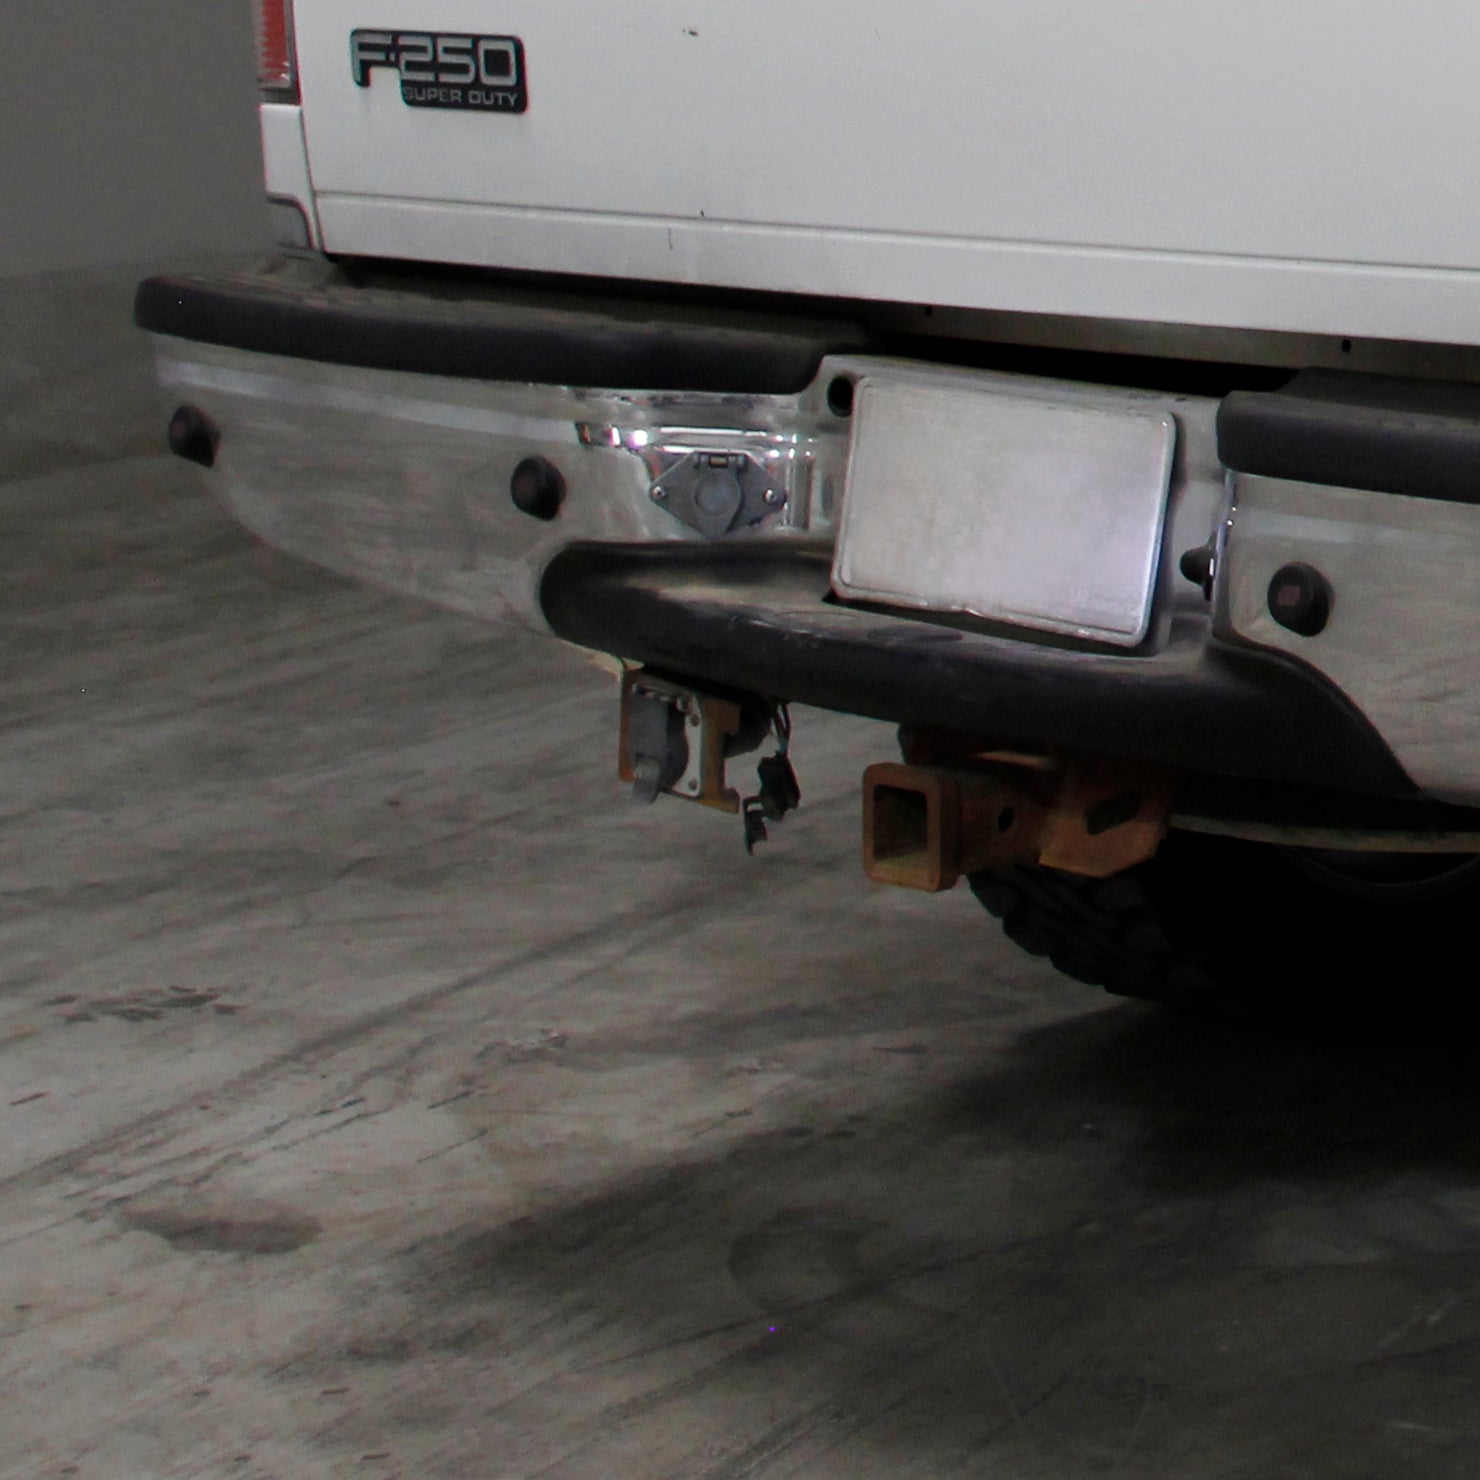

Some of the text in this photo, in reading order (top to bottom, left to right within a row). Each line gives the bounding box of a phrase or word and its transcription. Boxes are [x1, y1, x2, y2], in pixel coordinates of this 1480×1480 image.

[351, 31, 518, 87] F-250
[403, 86, 518, 106] SUPER DUTY
